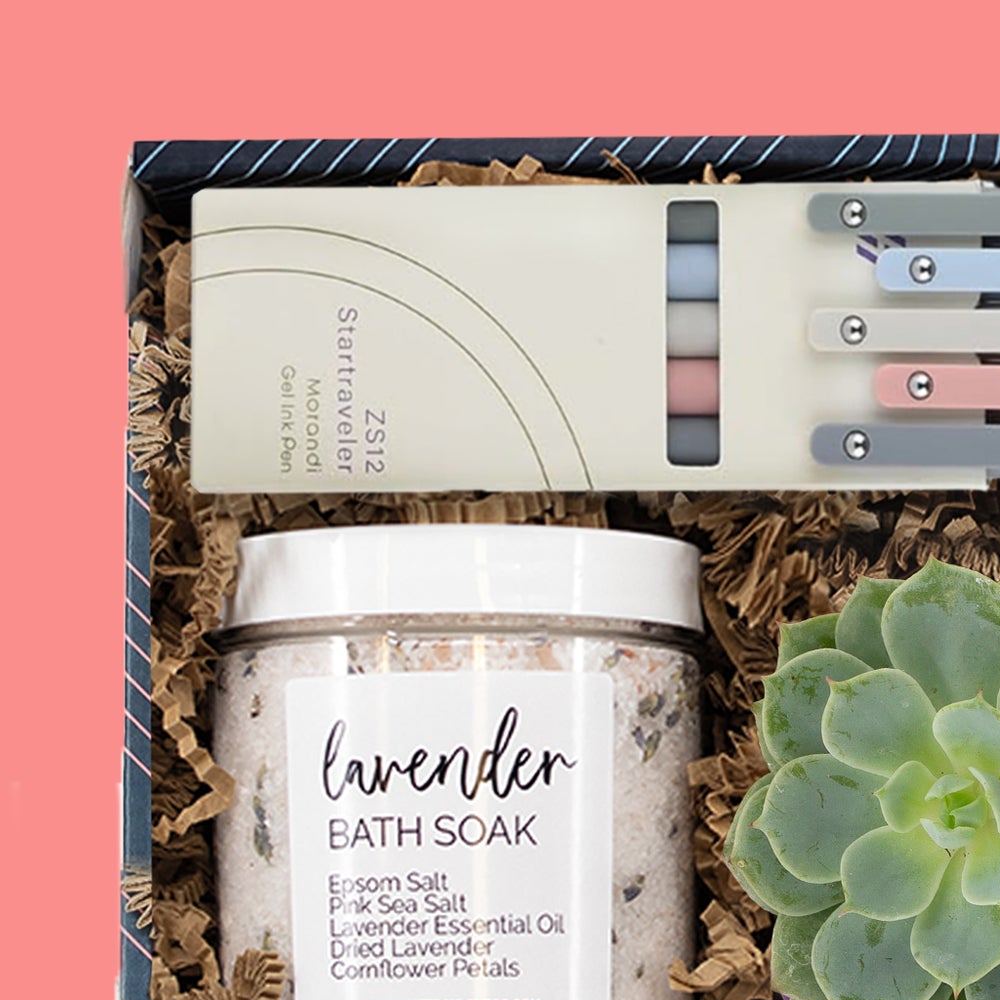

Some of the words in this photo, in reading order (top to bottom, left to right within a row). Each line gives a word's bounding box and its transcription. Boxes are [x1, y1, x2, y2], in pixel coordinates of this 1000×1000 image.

[281, 365, 296, 398] Gel
[336, 306, 358, 474] Startraveler
[281, 404, 294, 431] Ink
[305, 378, 322, 473] Morandi
[365, 409, 386, 474] ZS12
[322, 707, 577, 800] lavender
[328, 816, 422, 849] BATH
[434, 815, 537, 846] SOAK
[328, 875, 401, 897] Epsom
[406, 872, 448, 891] Salt
[328, 898, 371, 914] Pink
[378, 896, 417, 913] Sea
[424, 895, 467, 912] Salt
[329, 916, 428, 937] Lavender
[434, 915, 531, 935] Essential
[536, 913, 565, 933] Oil
[330, 940, 384, 958] Dried
[391, 938, 494, 956] Lavender
[330, 961, 445, 979] Cornflower
[452, 958, 520, 977] Petals
